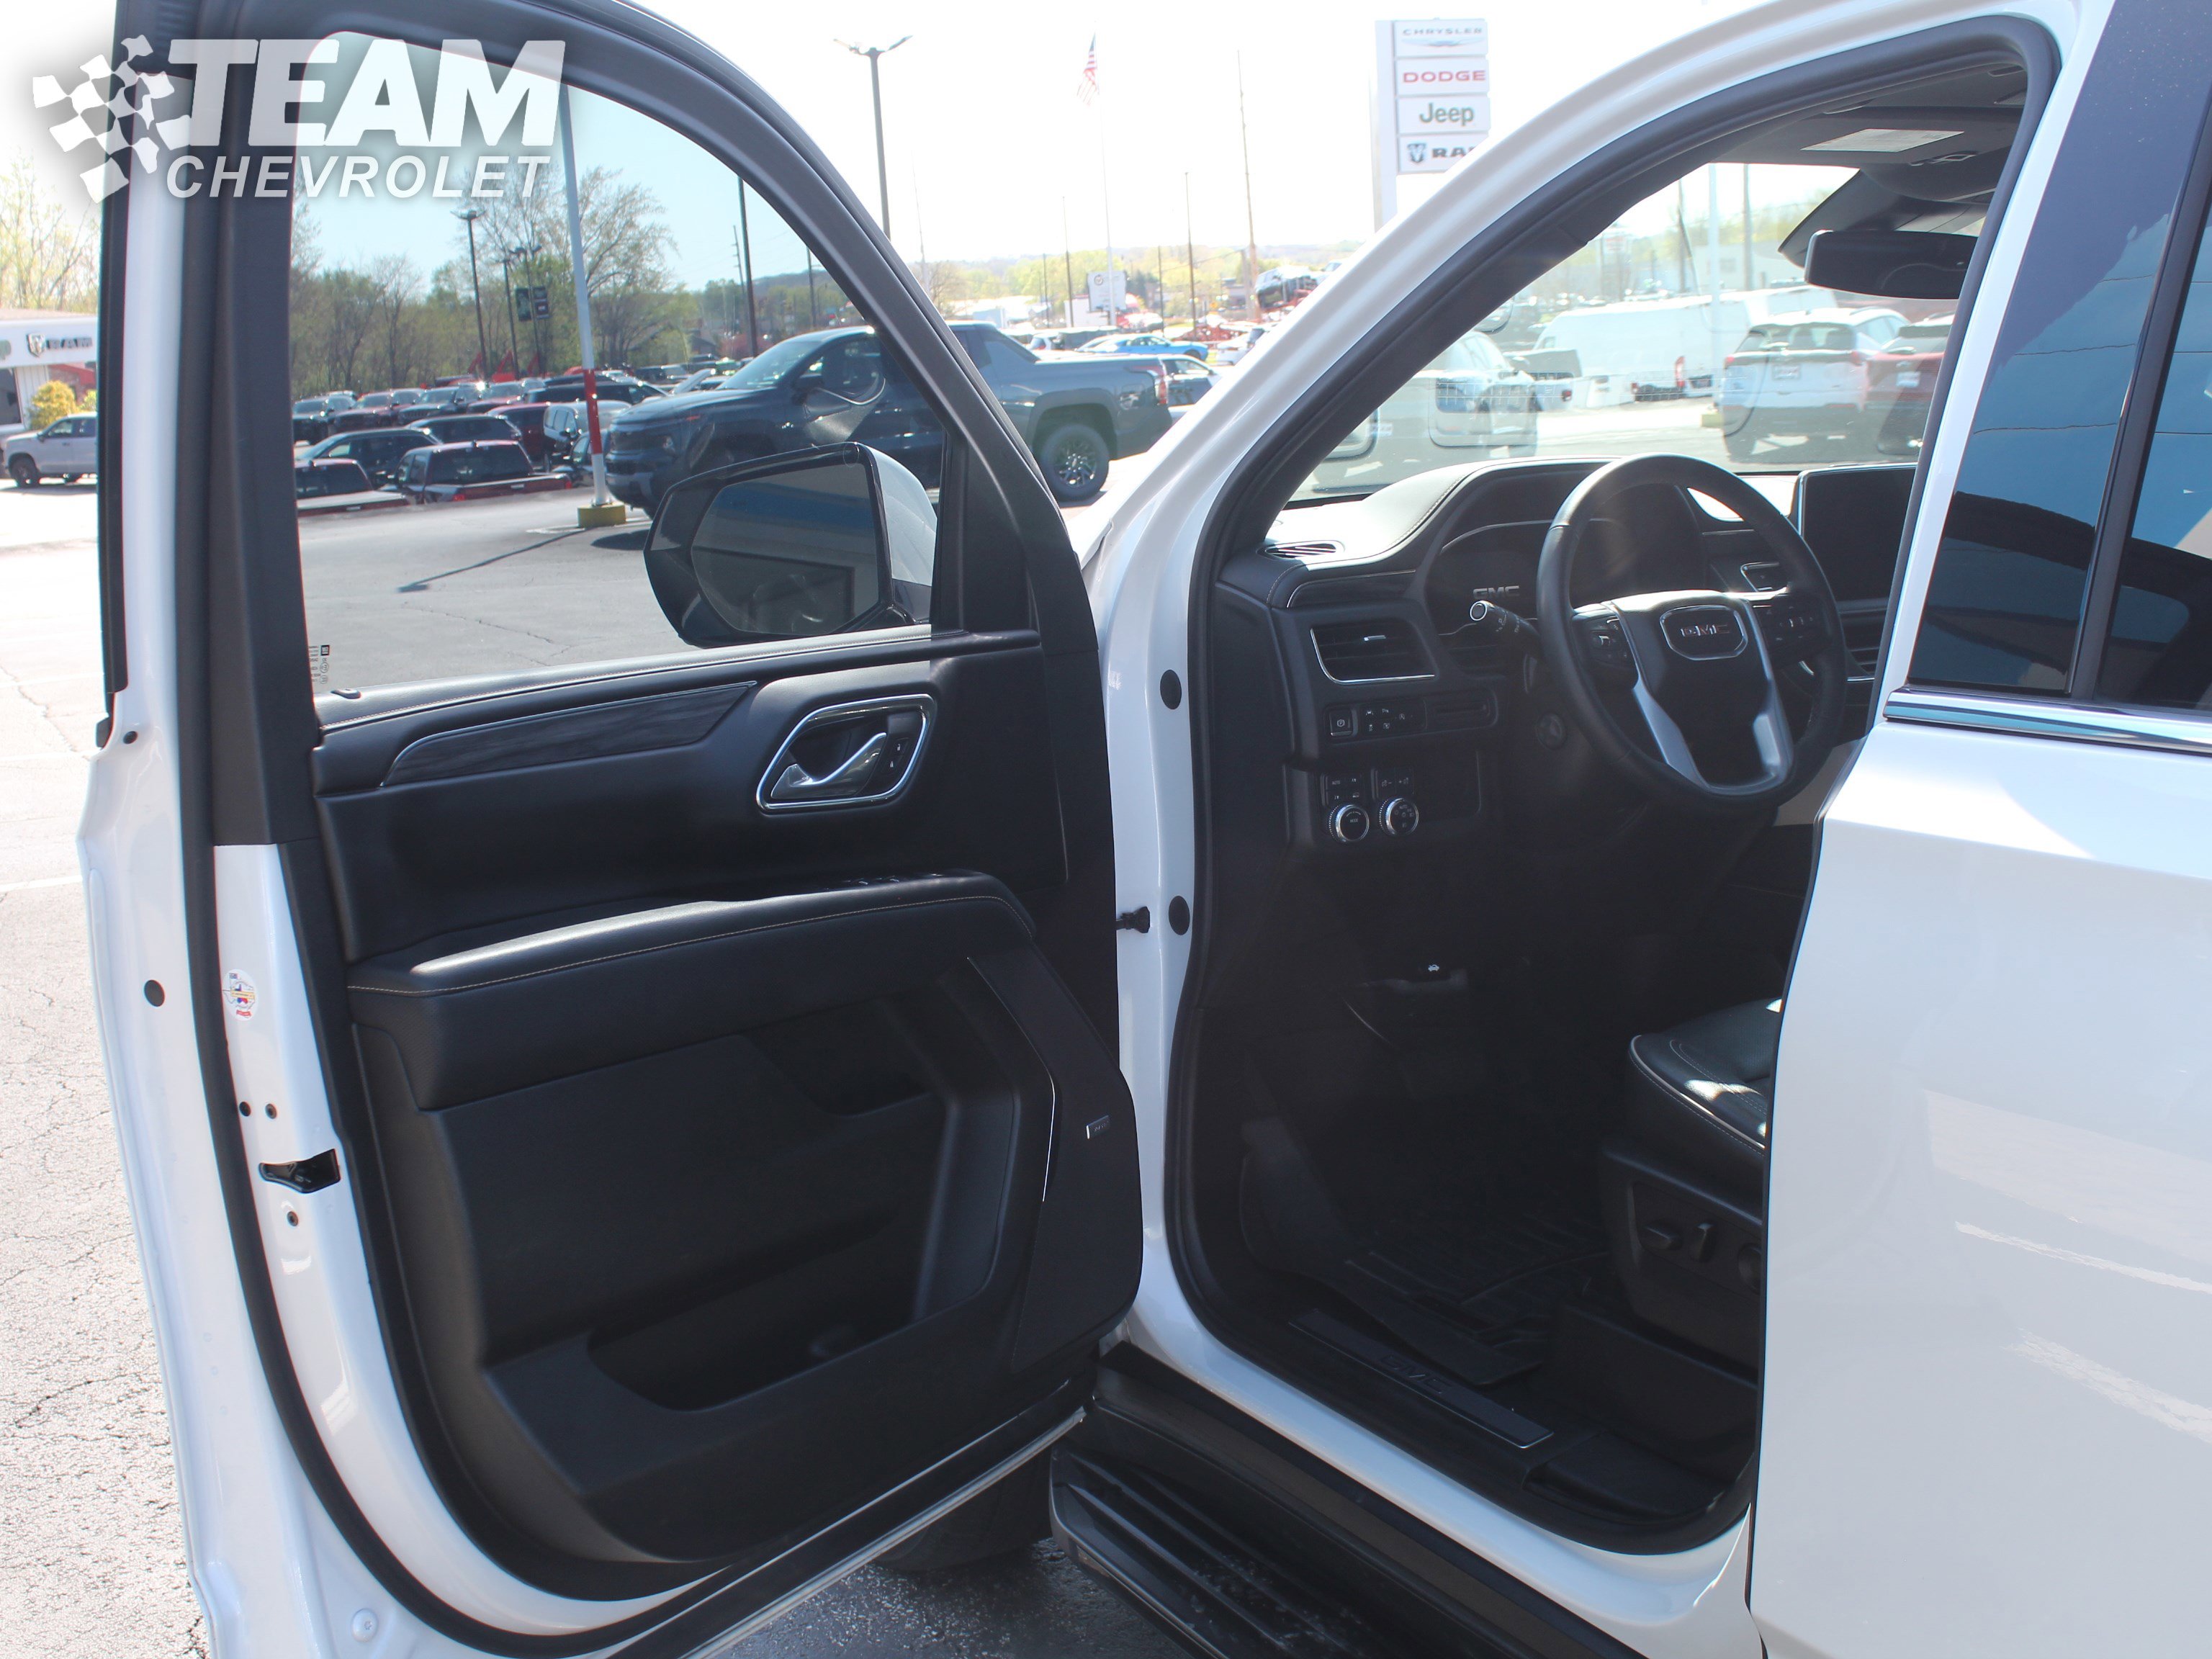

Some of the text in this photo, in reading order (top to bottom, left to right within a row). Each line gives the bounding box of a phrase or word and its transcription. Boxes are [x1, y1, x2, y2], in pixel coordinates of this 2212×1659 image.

[1403, 70, 1485, 83] DODGE
[1419, 102, 1474, 126] Jeep
[1432, 146, 1475, 158] RA
[46, 337, 93, 349] RAM
[1680, 624, 1730, 637] GMC
